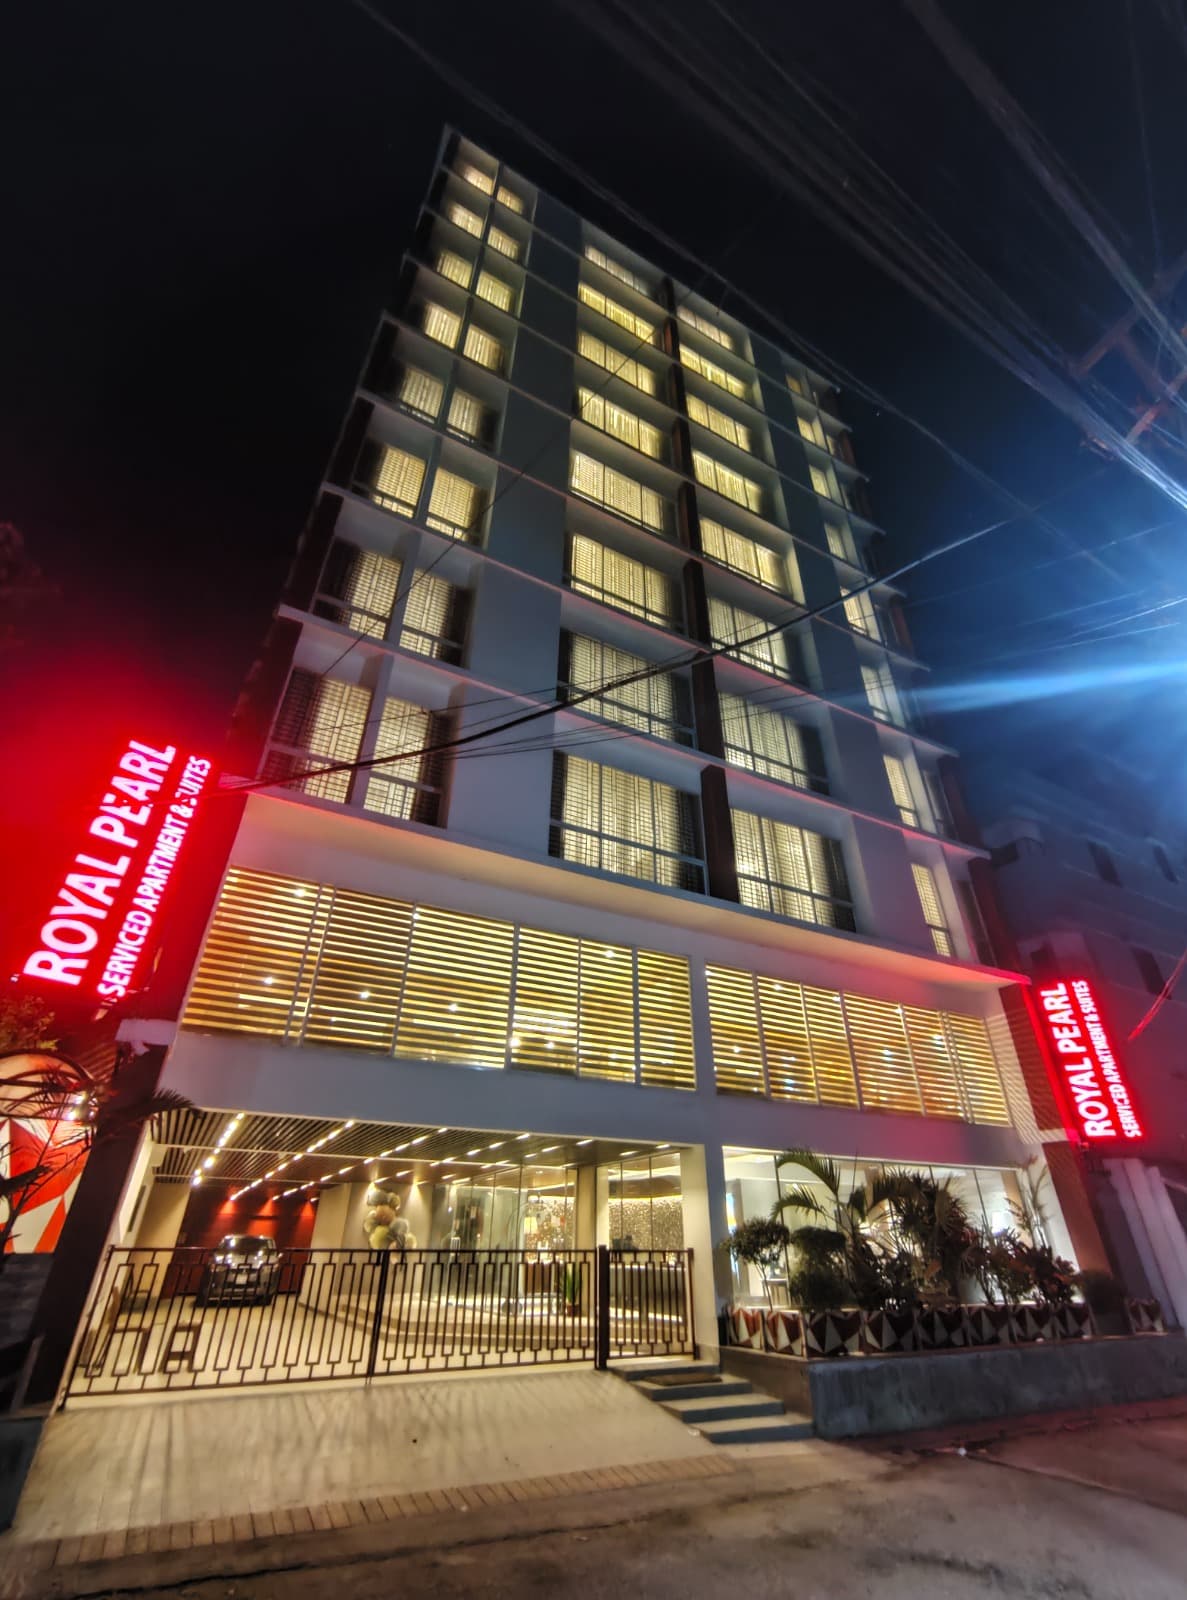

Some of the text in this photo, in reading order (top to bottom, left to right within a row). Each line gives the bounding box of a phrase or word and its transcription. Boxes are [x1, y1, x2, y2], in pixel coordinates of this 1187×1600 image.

[23, 740, 177, 986] ROYAL PEARL
[96, 910, 153, 998] SERVICED
[132, 813, 189, 912] APARTMENT
[169, 803, 194, 819] &
[1071, 980, 1098, 1013] SUITES
[1039, 982, 1117, 1138] ROYAL PEARL
[1085, 1021, 1122, 1085] APARTMENT
[1108, 1084, 1142, 1138] SERVICED
